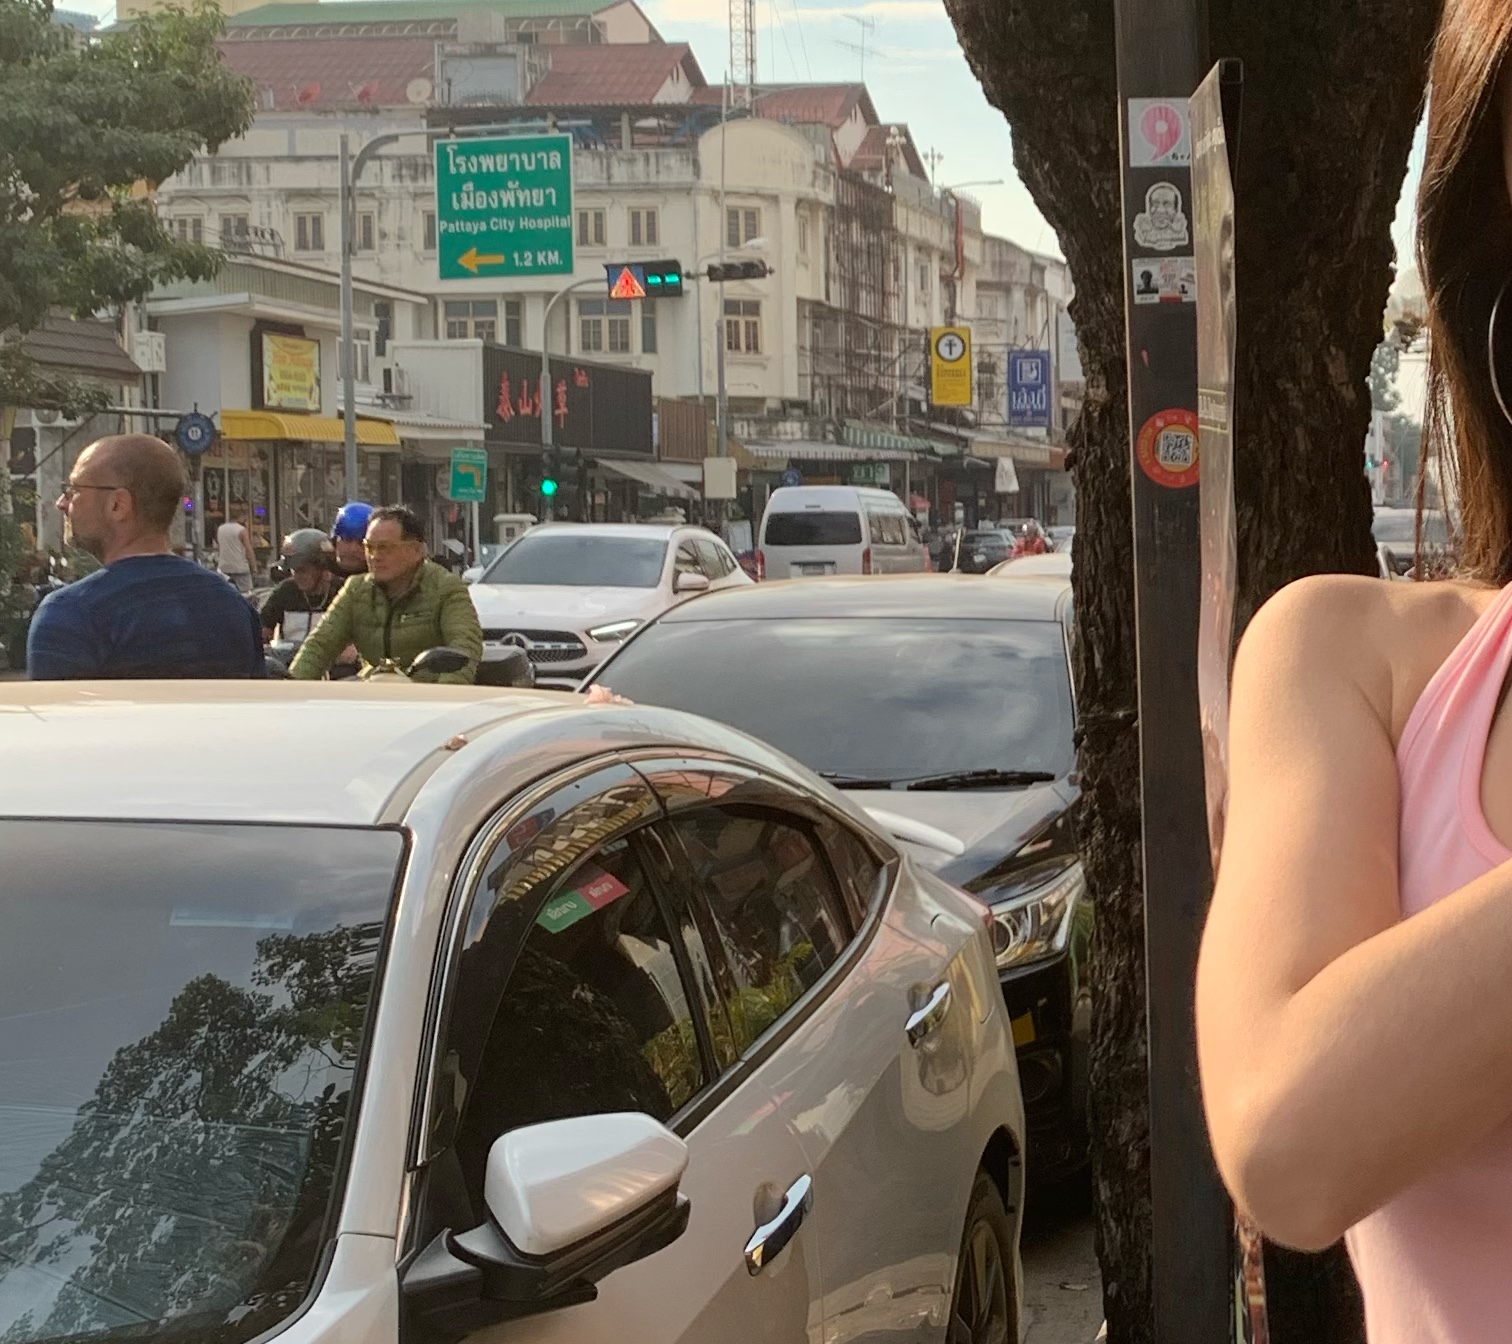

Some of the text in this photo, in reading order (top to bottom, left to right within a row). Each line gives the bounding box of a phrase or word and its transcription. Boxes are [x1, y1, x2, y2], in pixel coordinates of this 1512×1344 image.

[446, 144, 561, 174] โรงพยาบาล
[452, 180, 557, 210] เมืองพัทยา
[440, 215, 572, 234] Pattaya City Hospital
[513, 250, 563, 267] 1.2 KM.
